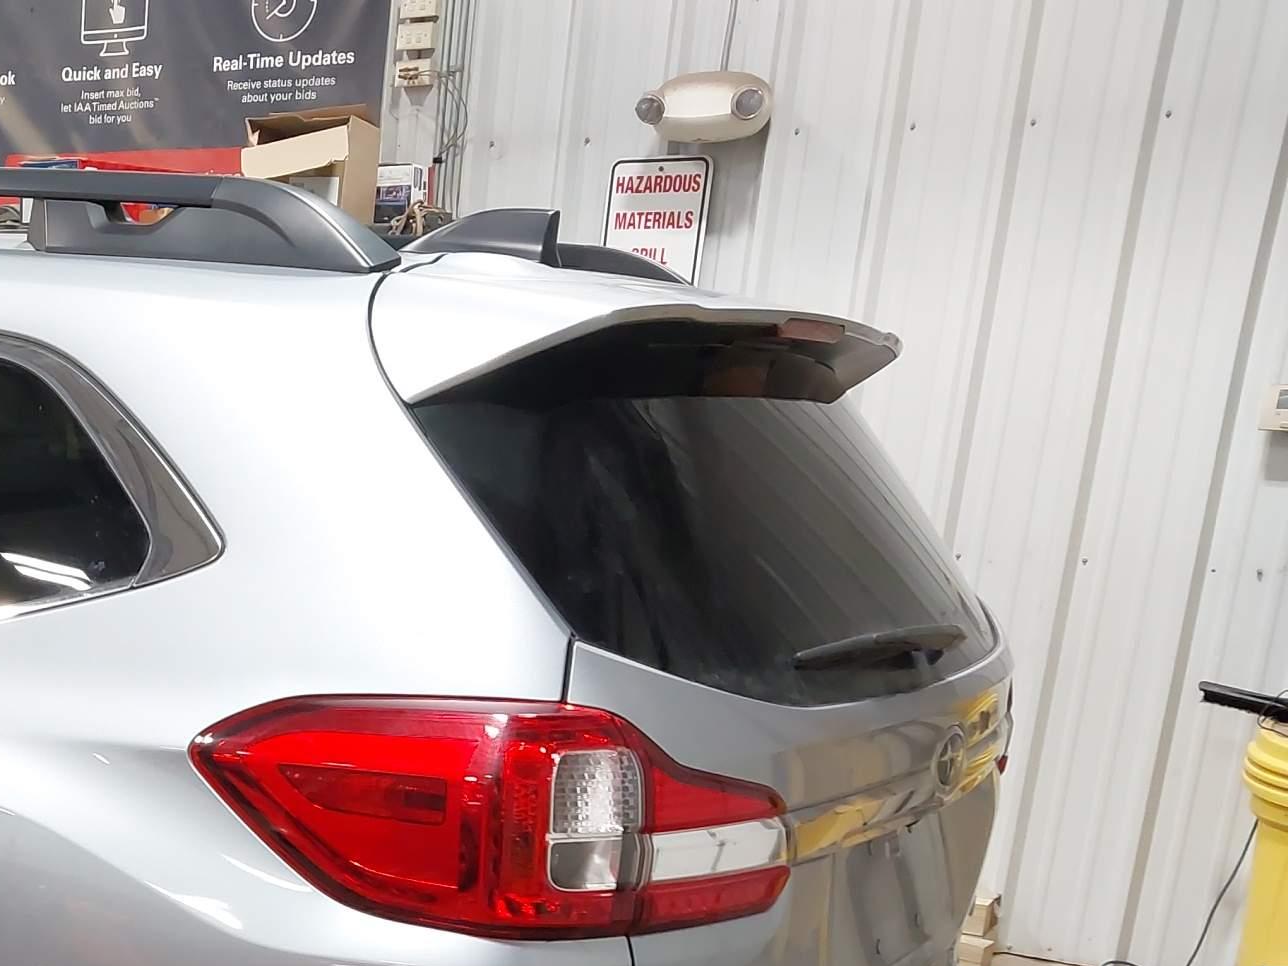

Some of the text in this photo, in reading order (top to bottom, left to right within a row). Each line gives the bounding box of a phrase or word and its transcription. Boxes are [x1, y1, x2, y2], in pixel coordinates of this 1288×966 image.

[213, 50, 355, 72] Real-Time Updates
[62, 62, 162, 81] Quick and Easy
[227, 75, 336, 91] Receive status updates
[81, 87, 142, 100] Insert max bid,
[241, 89, 317, 103] about your bids
[61, 102, 72, 113] let
[74, 101, 92, 112] IAA
[93, 100, 117, 111] Timed
[89, 113, 132, 124] bid for you
[616, 174, 702, 194] HAZARDOUS
[614, 211, 695, 230] MATERIALS
